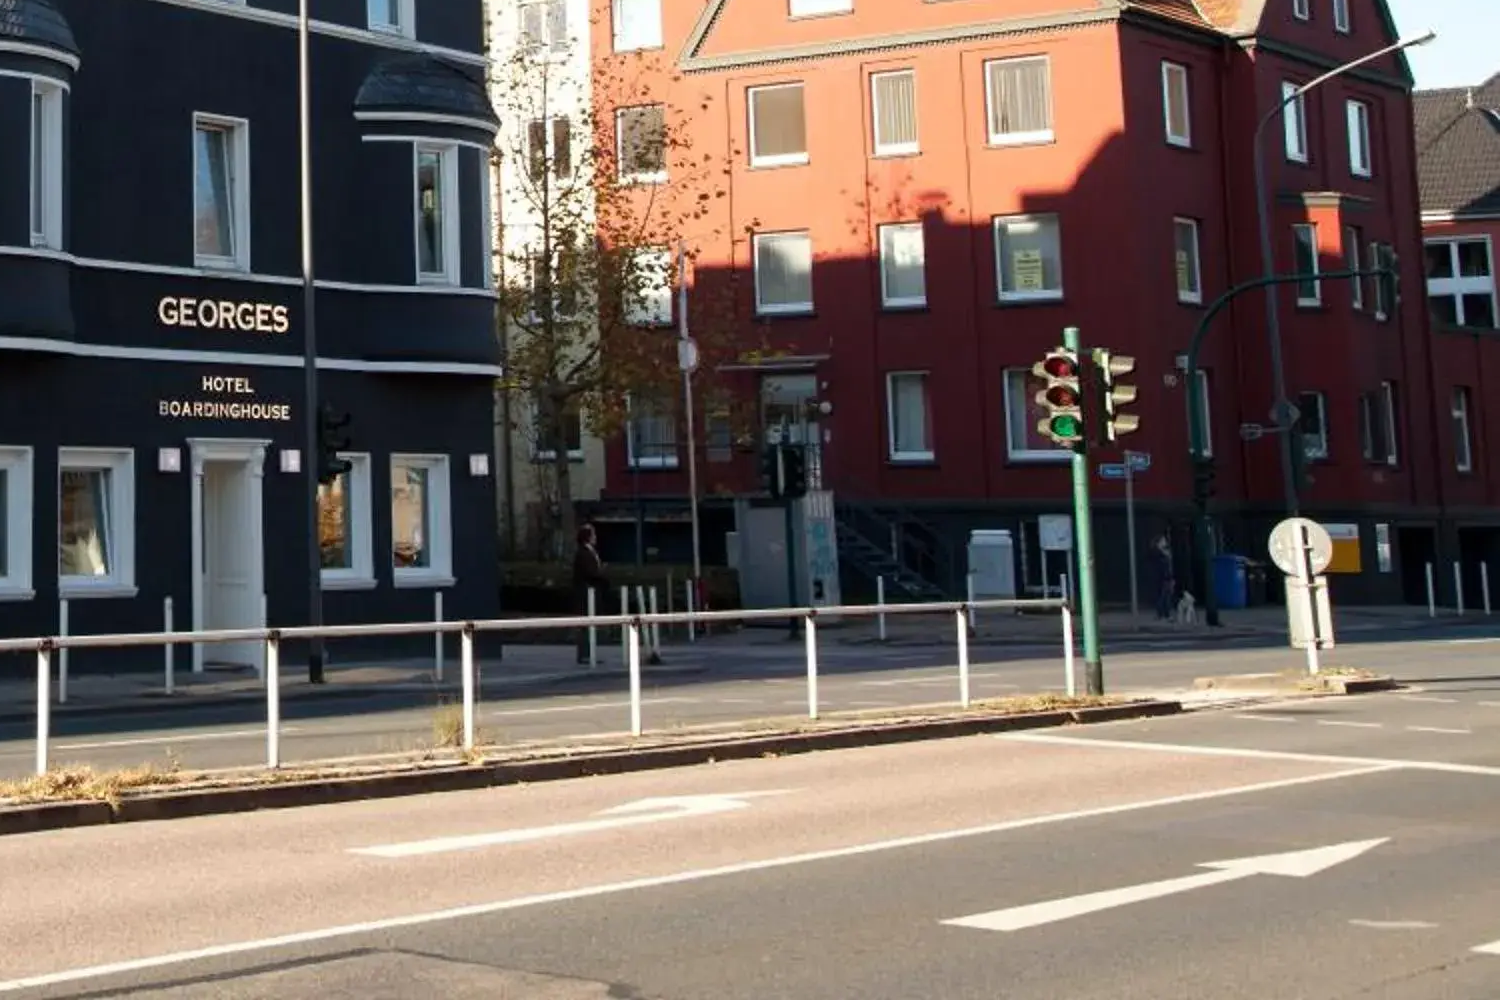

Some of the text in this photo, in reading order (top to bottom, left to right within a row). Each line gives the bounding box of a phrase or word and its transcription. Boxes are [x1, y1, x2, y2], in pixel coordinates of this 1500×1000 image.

[159, 297, 289, 332] GEORGES
[203, 376, 254, 393] HOTEL
[160, 402, 290, 419] BOARDINGHOUSE
